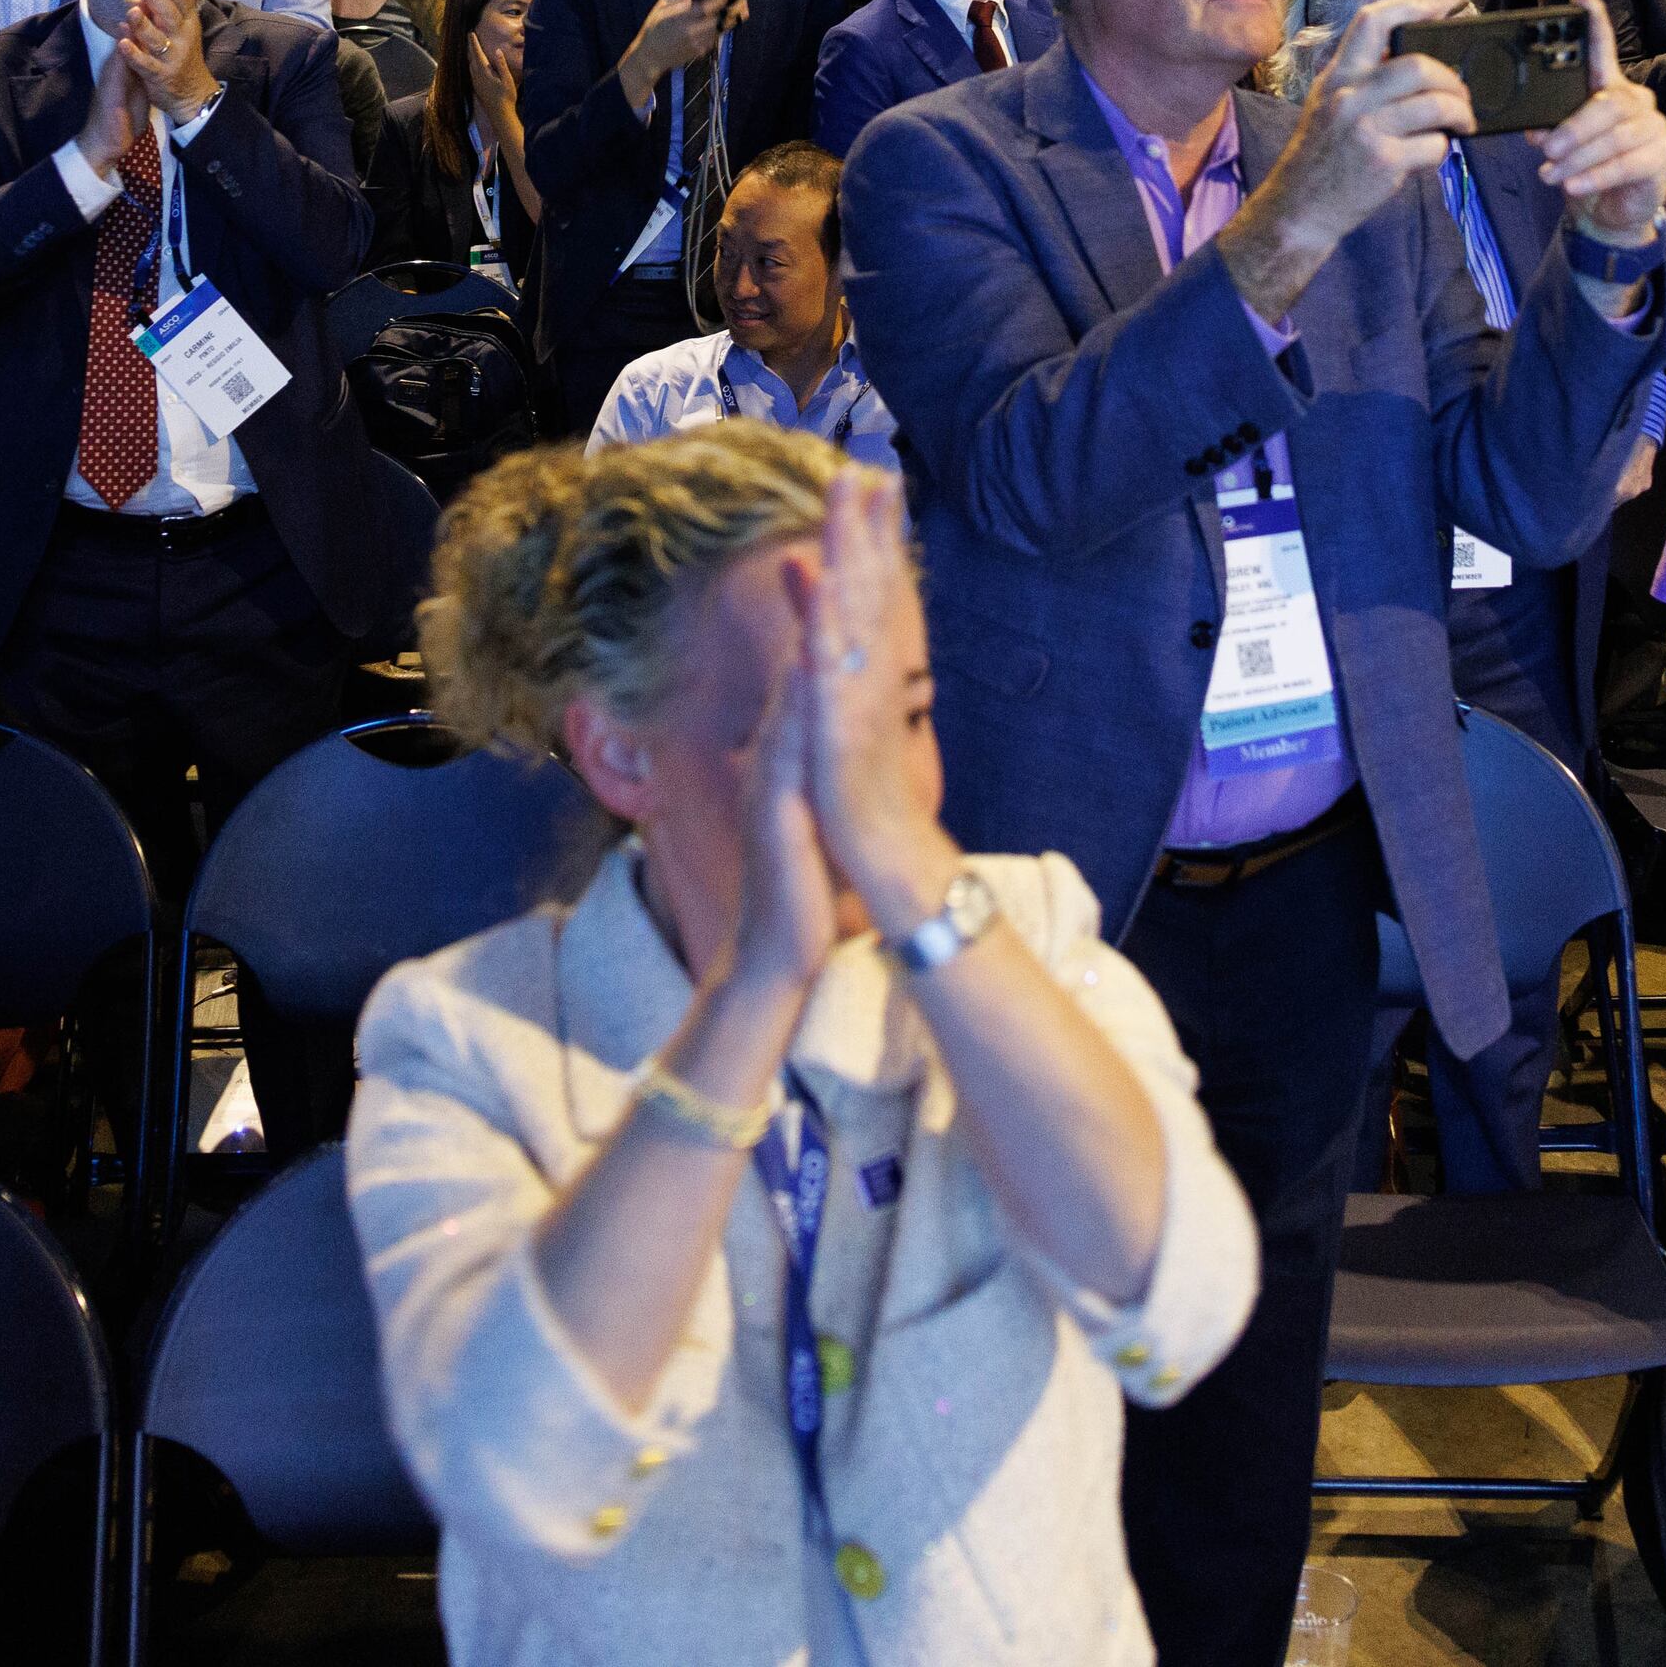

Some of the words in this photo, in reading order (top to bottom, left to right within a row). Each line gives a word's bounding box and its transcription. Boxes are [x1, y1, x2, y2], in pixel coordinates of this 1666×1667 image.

[144, 231, 160, 260] ASCO
[159, 314, 180, 335] ASCO
[184, 331, 215, 359] CARMINE
[198, 346, 215, 360] PINTO
[241, 394, 263, 414] MEMBER
[722, 385, 736, 406] ASCO
[1209, 714, 1255, 733] Patient
[1261, 702, 1318, 720] Advocate
[1239, 737, 1309, 762] Member
